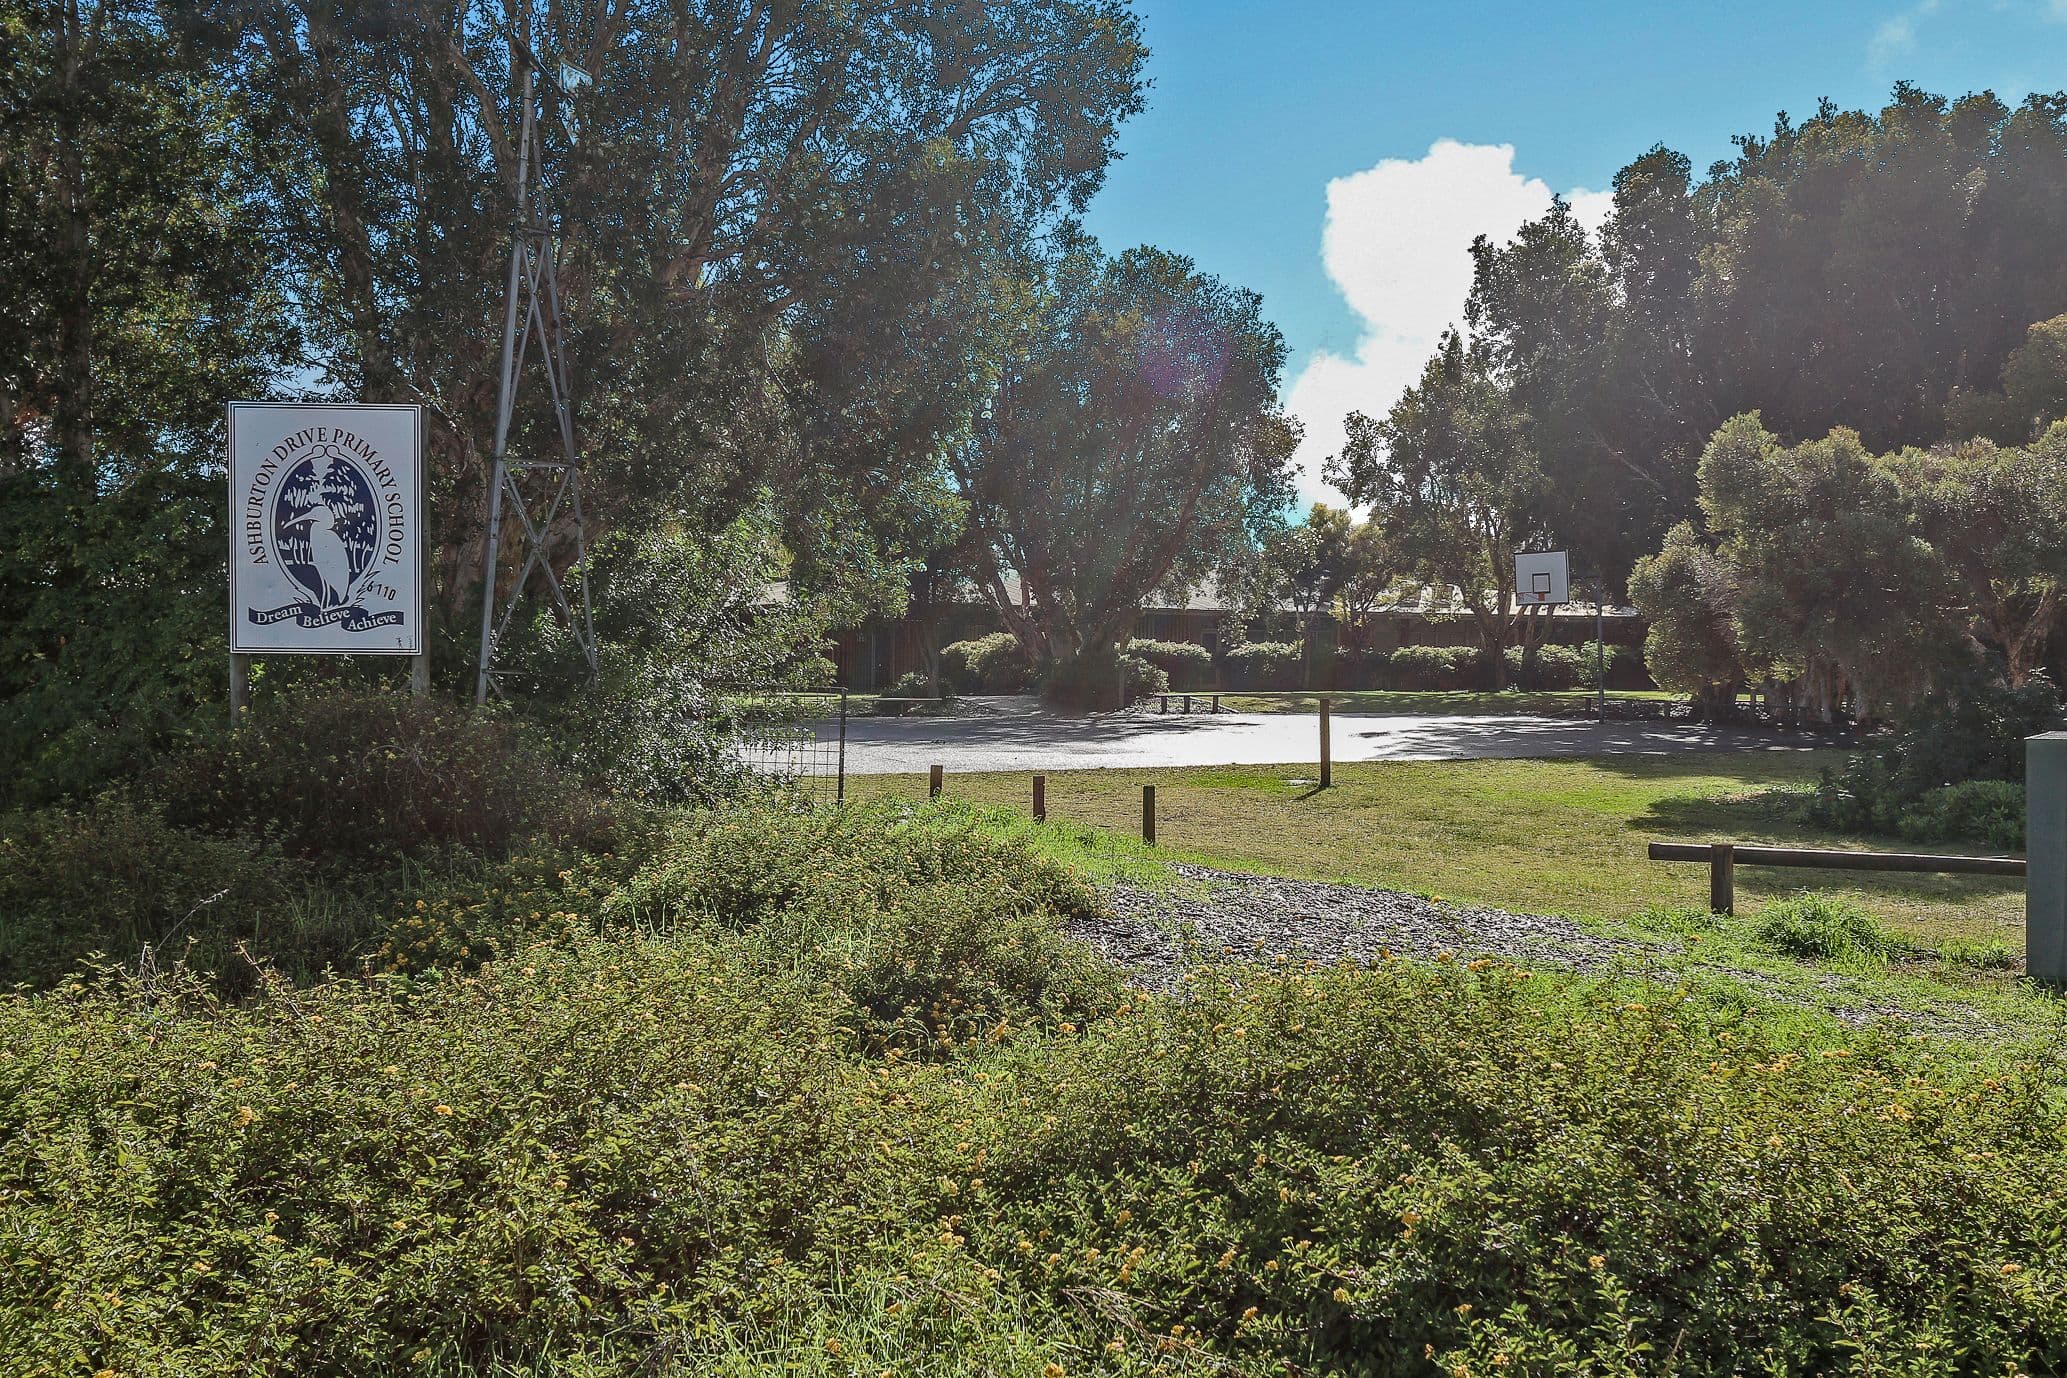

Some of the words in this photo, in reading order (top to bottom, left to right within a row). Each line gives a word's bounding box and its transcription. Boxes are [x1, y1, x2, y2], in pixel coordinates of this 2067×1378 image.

[246, 458, 279, 565] ASHBURTON
[271, 427, 328, 462] DRIVE
[331, 428, 397, 490] PRIMARY
[382, 492, 405, 565] SCHOOL
[256, 606, 303, 623] Dream
[302, 609, 350, 627] Believe
[346, 613, 397, 631] Achieve
